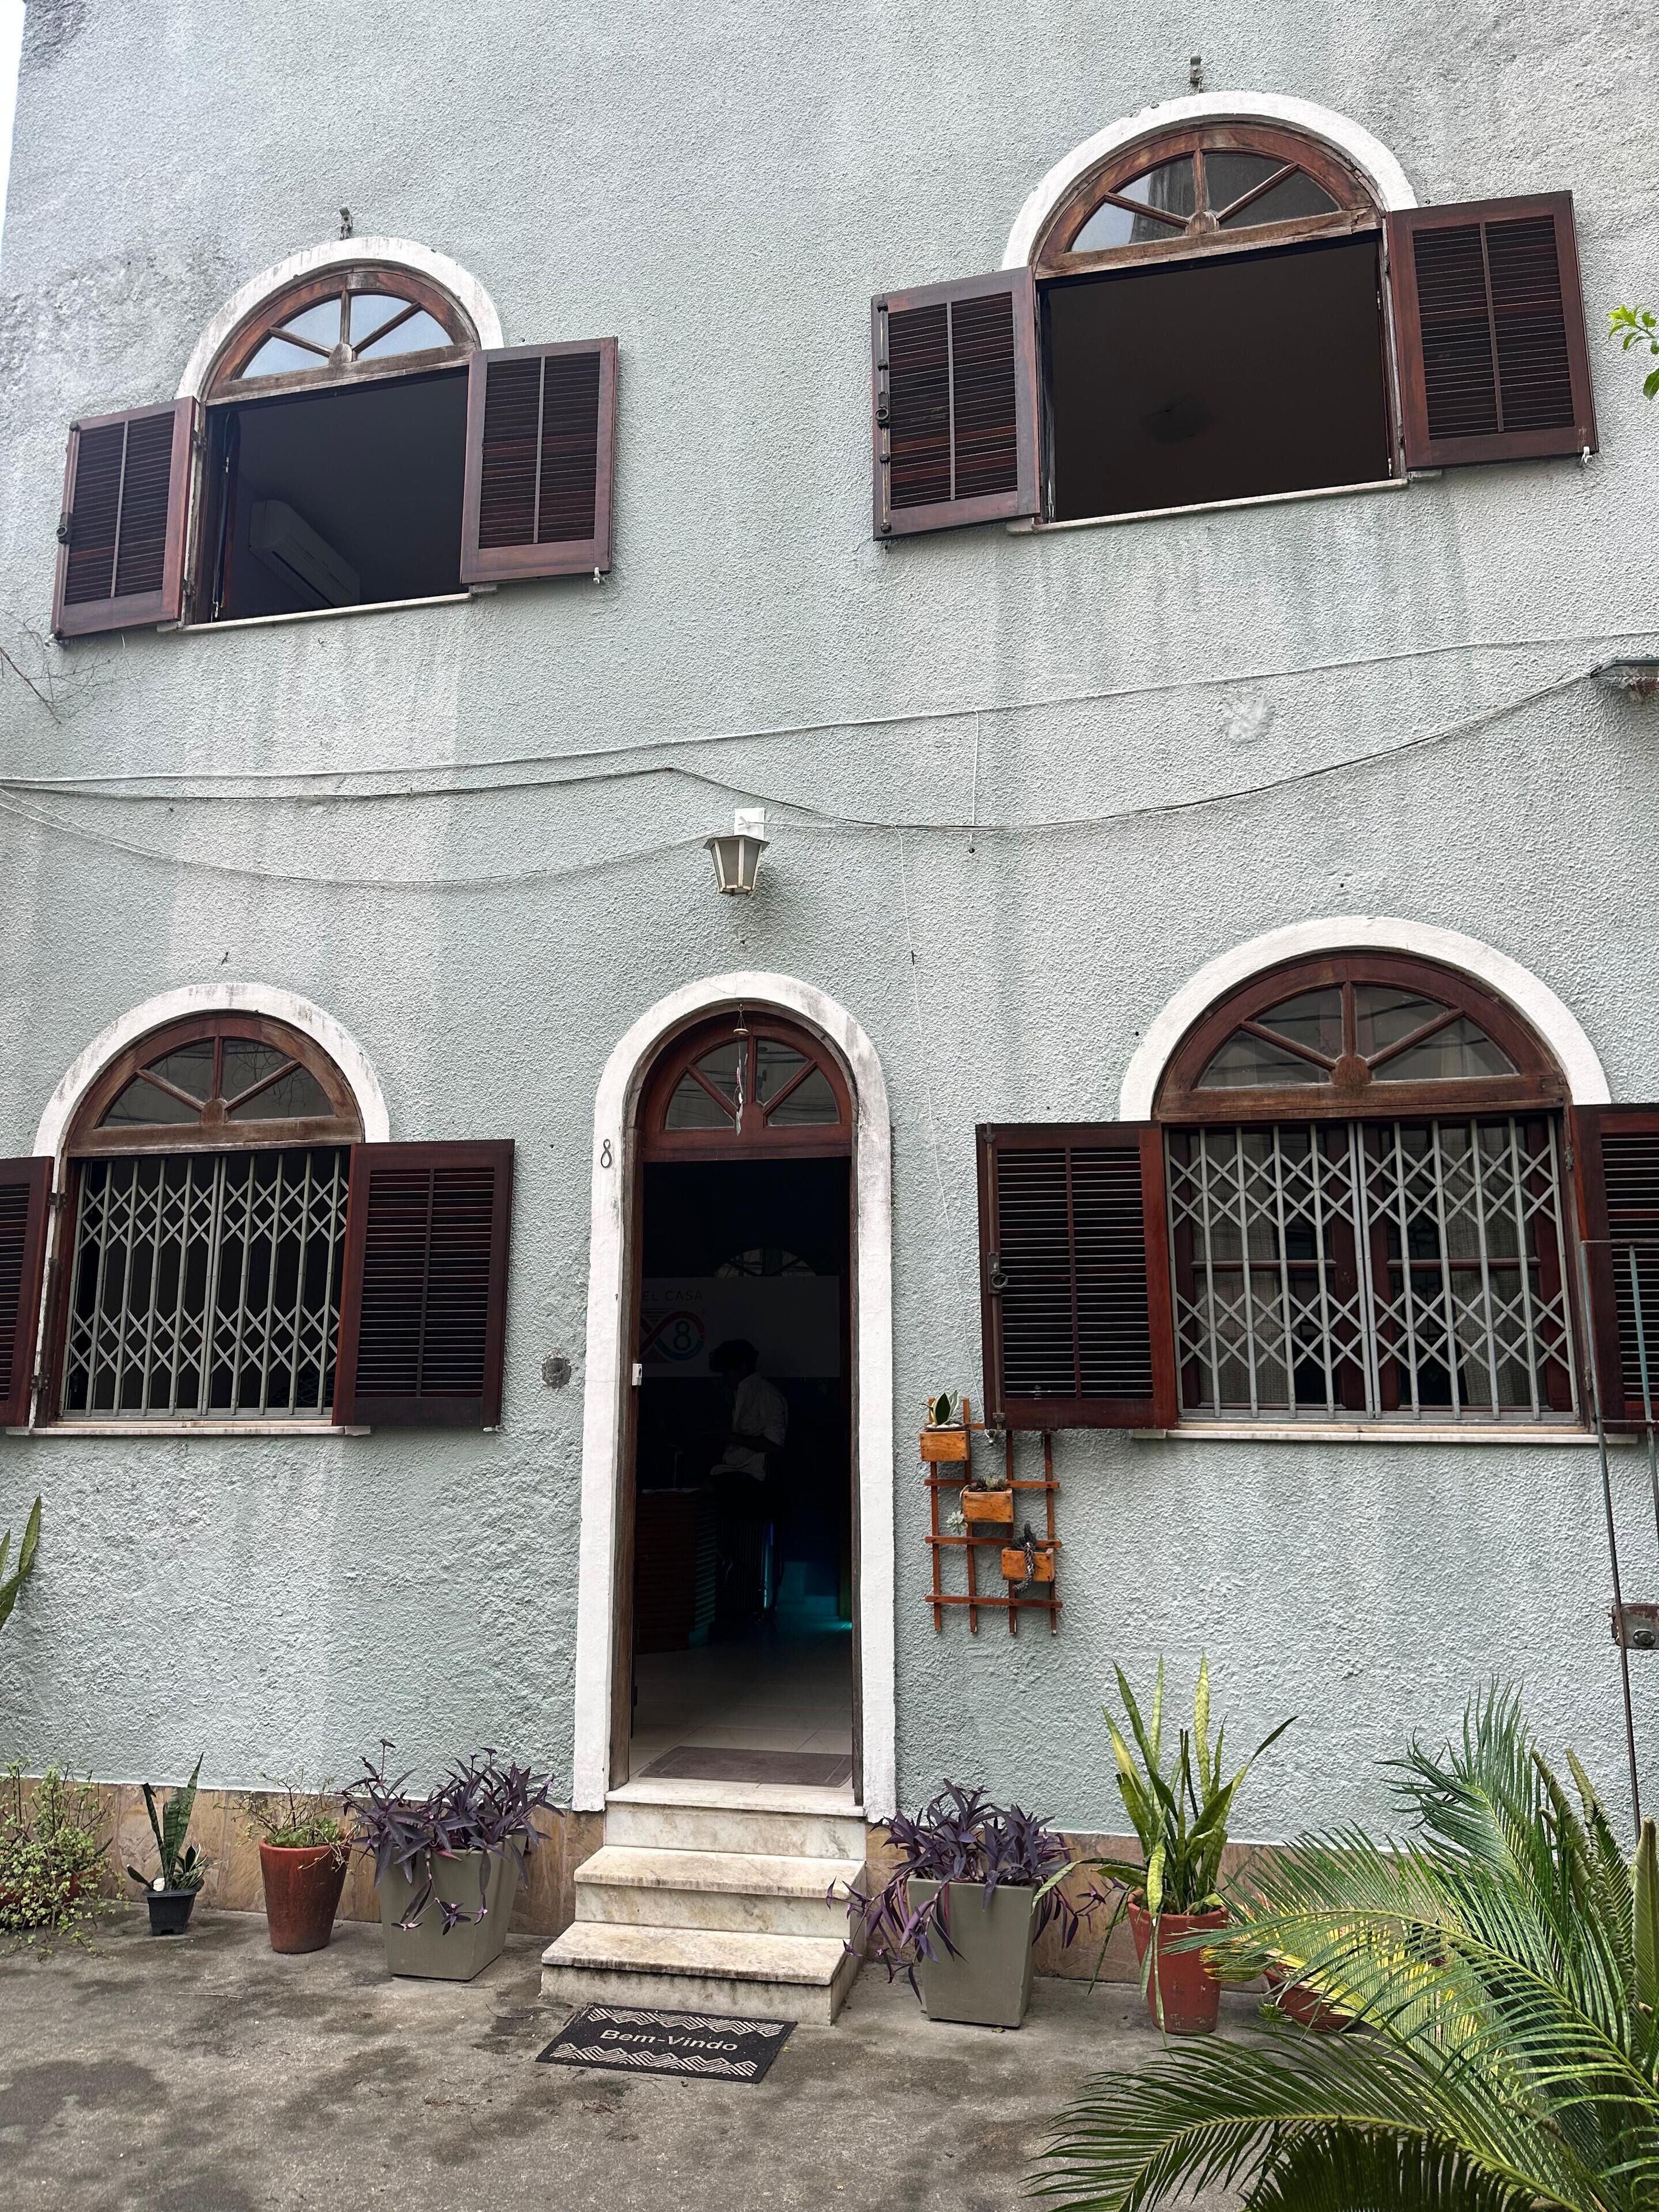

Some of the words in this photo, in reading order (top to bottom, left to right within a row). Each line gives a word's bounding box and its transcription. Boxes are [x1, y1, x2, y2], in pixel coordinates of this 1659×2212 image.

[600, 1138, 612, 1168] 8
[664, 1290, 703, 1301] CASA
[673, 1320, 691, 1351] 8
[599, 2029, 738, 2052] Bem-Vindo
